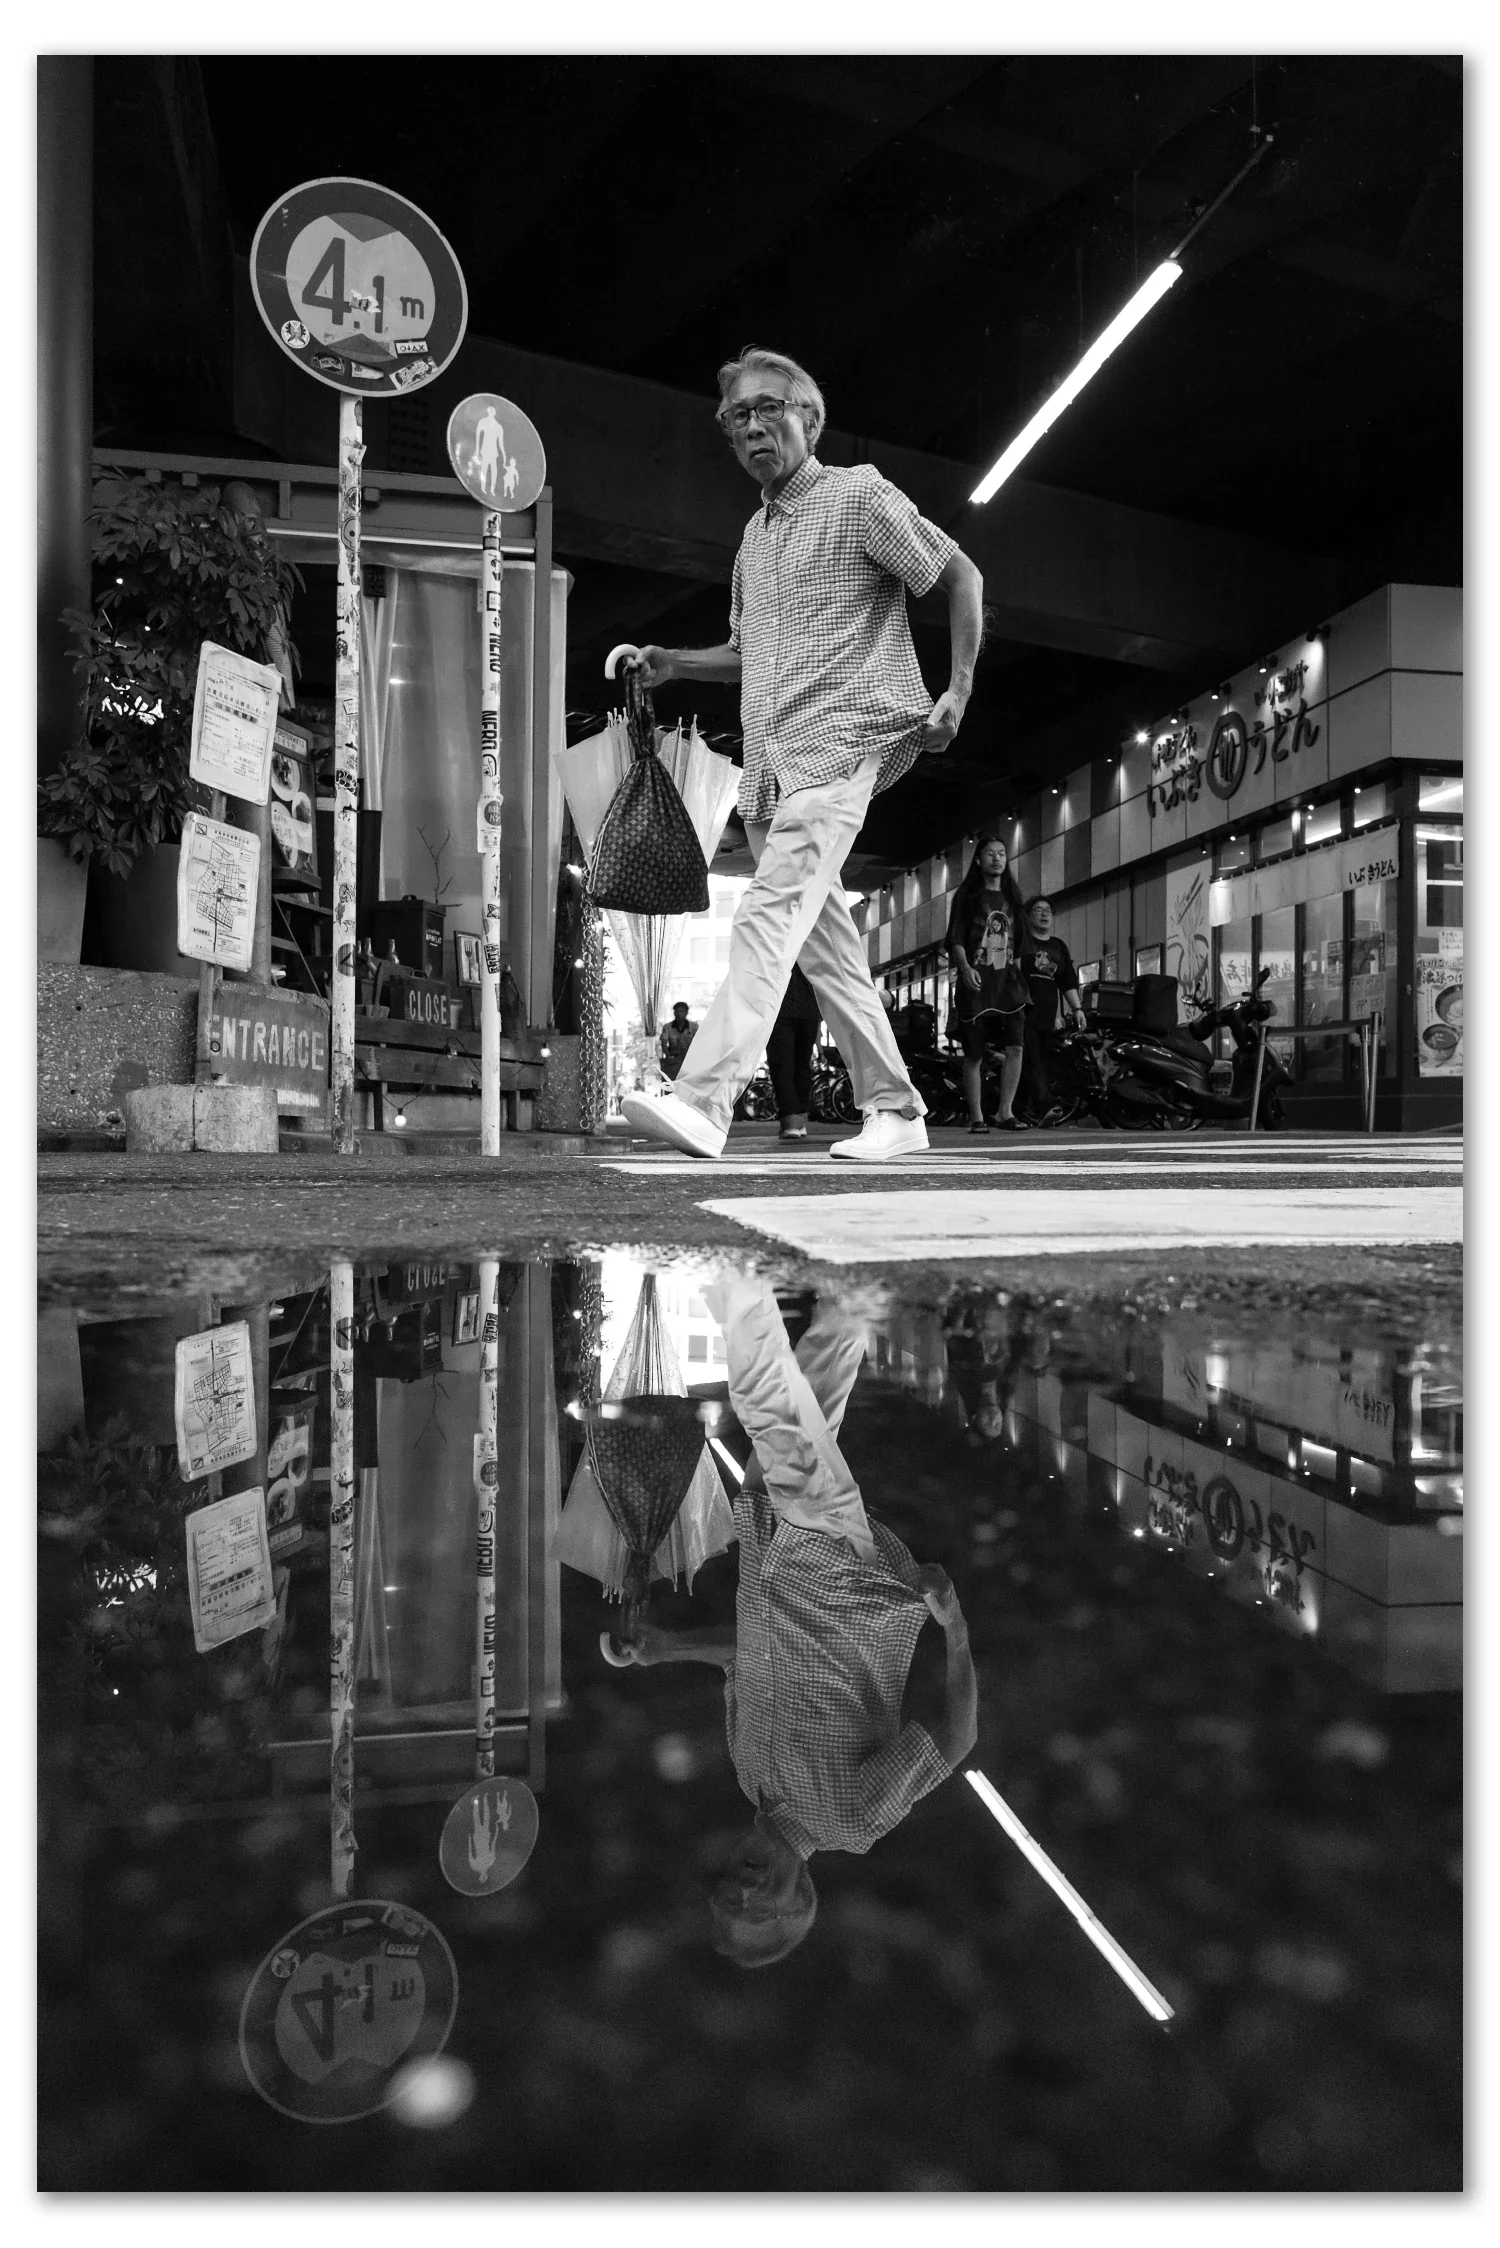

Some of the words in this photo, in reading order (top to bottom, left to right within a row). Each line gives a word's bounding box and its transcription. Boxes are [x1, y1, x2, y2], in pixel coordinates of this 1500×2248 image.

[301, 236, 385, 333] 4.1
[399, 296, 425, 321] m
[1250, 698, 1320, 775] うどん
[1349, 858, 1396, 884] いぶきうどん
[409, 989, 447, 1025] CLOSE
